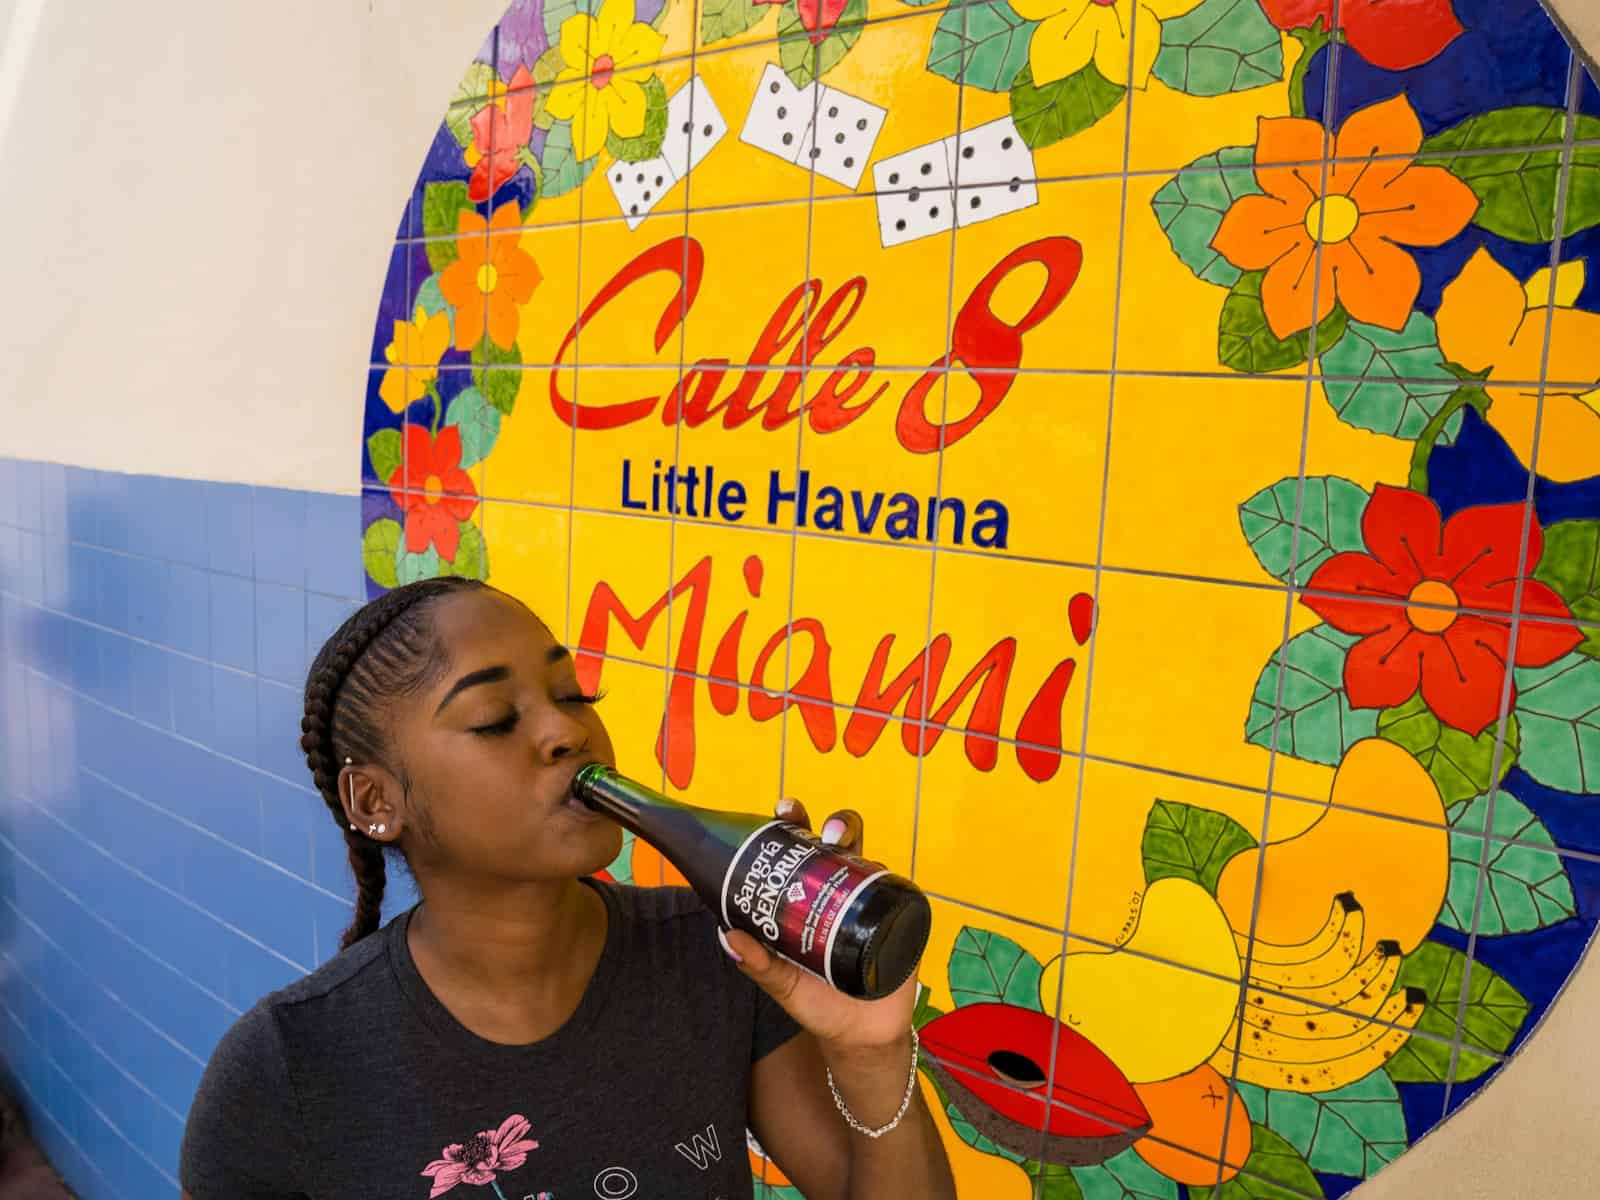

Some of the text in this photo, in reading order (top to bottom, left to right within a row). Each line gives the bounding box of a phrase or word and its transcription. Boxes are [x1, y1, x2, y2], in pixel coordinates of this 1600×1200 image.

[549, 236, 1083, 454] Calle 8
[620, 459, 1010, 550] Little Havana
[574, 555, 1099, 791] Miami
[734, 840, 784, 914] Sangría
[752, 843, 815, 941] SEÑORIAL
